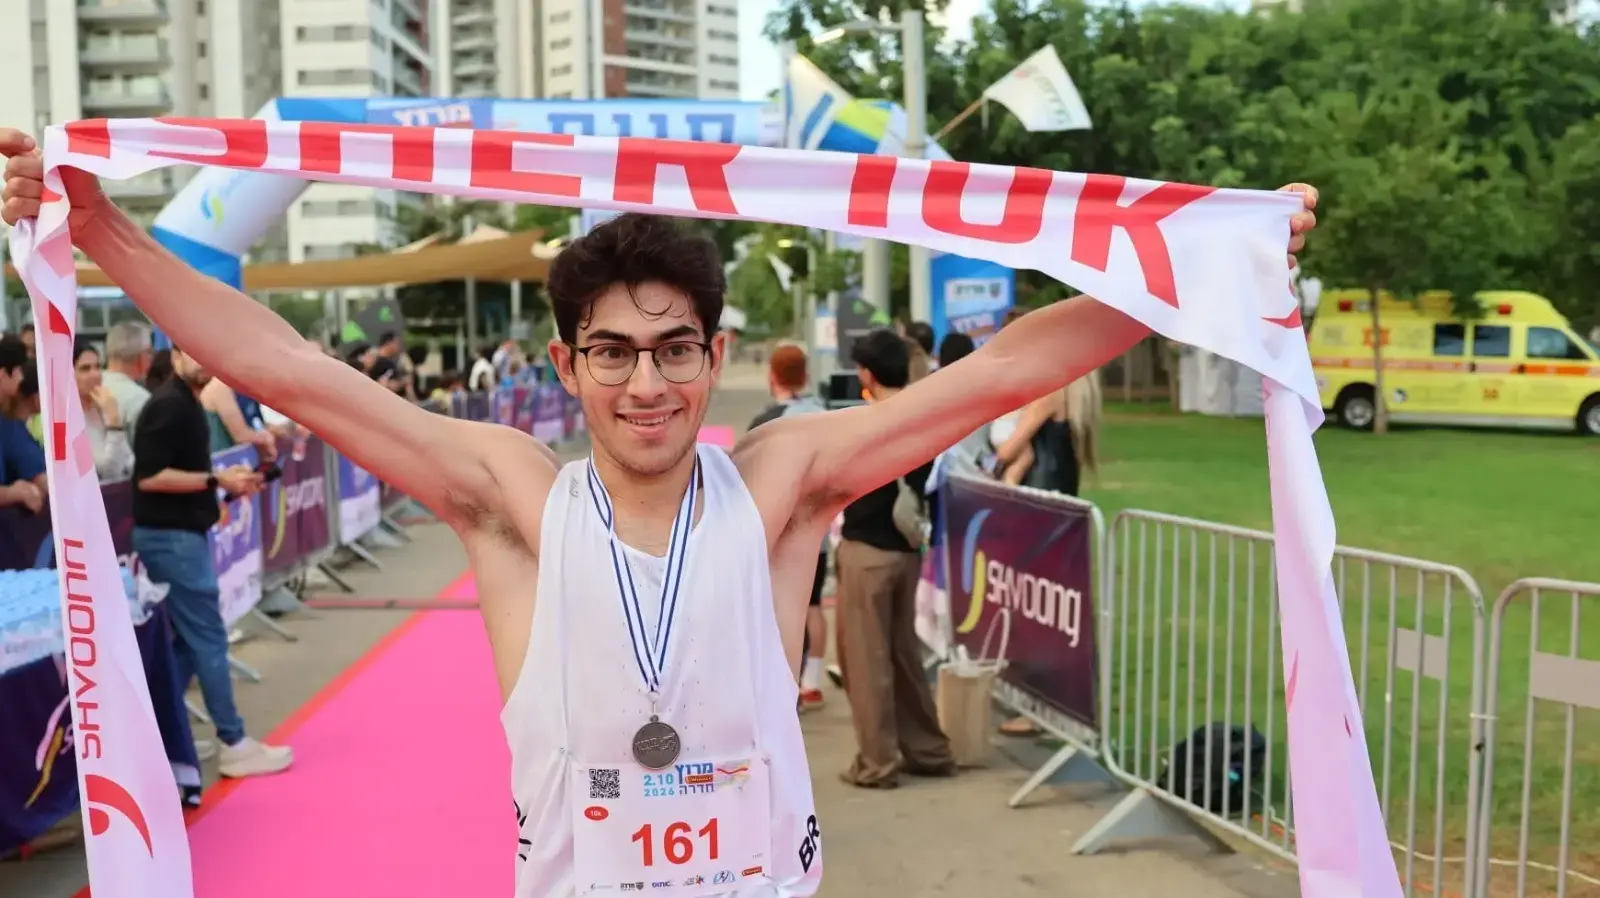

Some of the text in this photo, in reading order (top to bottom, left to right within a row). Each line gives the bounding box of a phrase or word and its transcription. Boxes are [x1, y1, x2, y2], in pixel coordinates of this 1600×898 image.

[643, 773, 674, 786] 2.10
[675, 762, 714, 784] מרוץ
[644, 787, 675, 797] 2026
[679, 783, 714, 795] חדרה
[632, 818, 719, 867] 161
